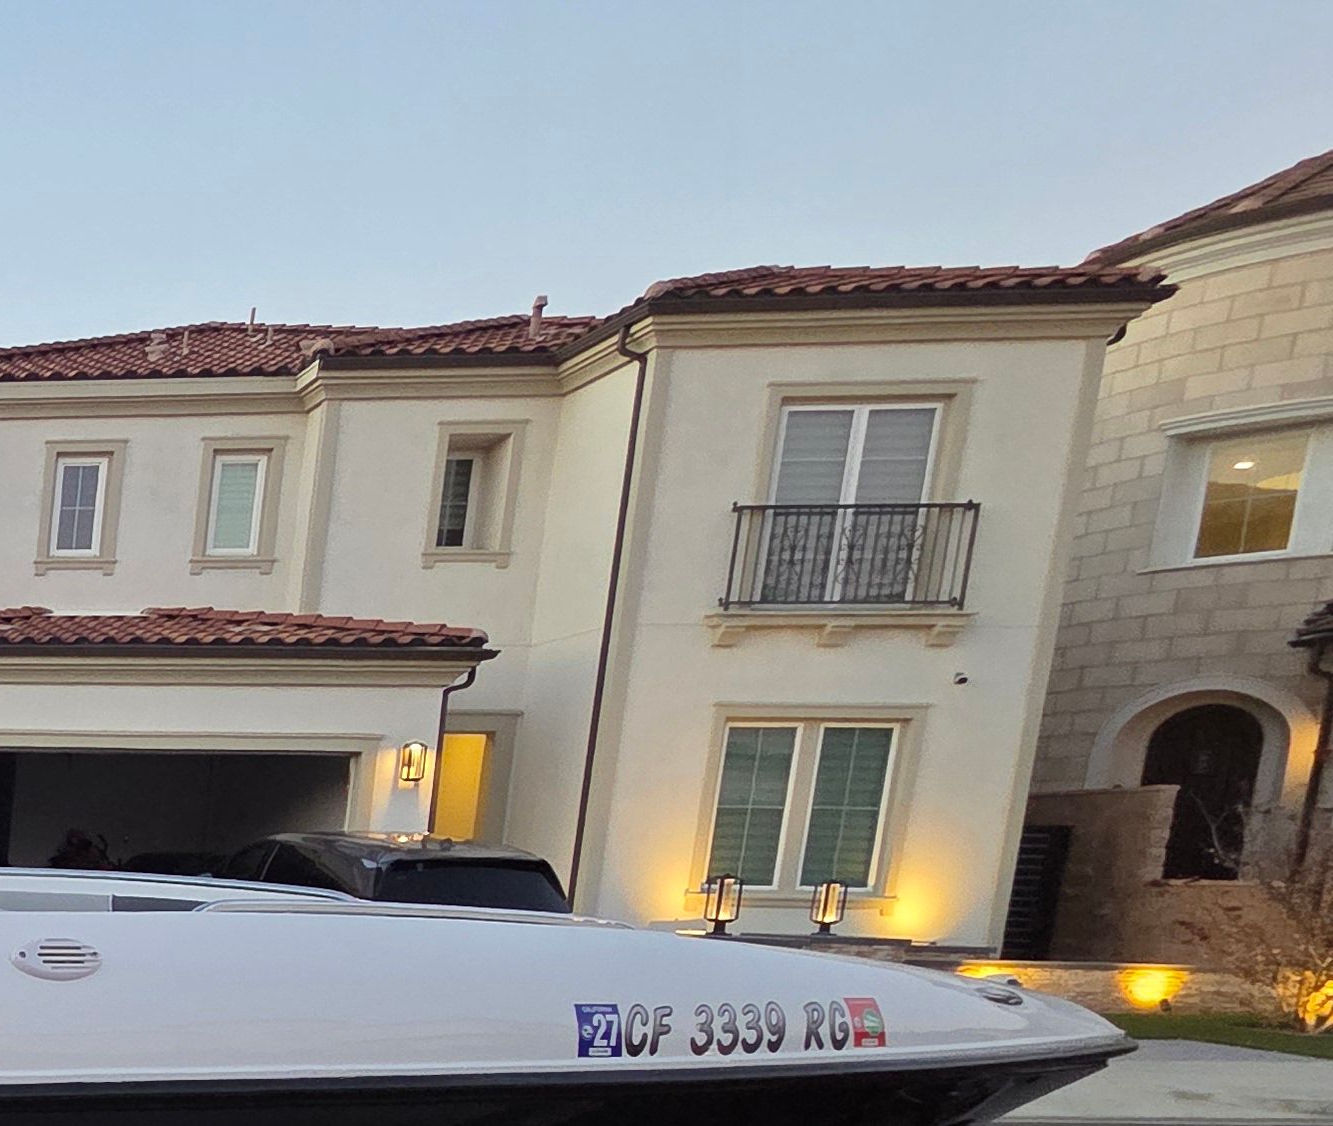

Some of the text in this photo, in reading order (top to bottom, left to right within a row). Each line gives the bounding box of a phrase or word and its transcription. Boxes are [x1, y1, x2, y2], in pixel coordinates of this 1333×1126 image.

[593, 1013, 619, 1047] 27
[625, 1001, 849, 1057] CF 3339 RG
